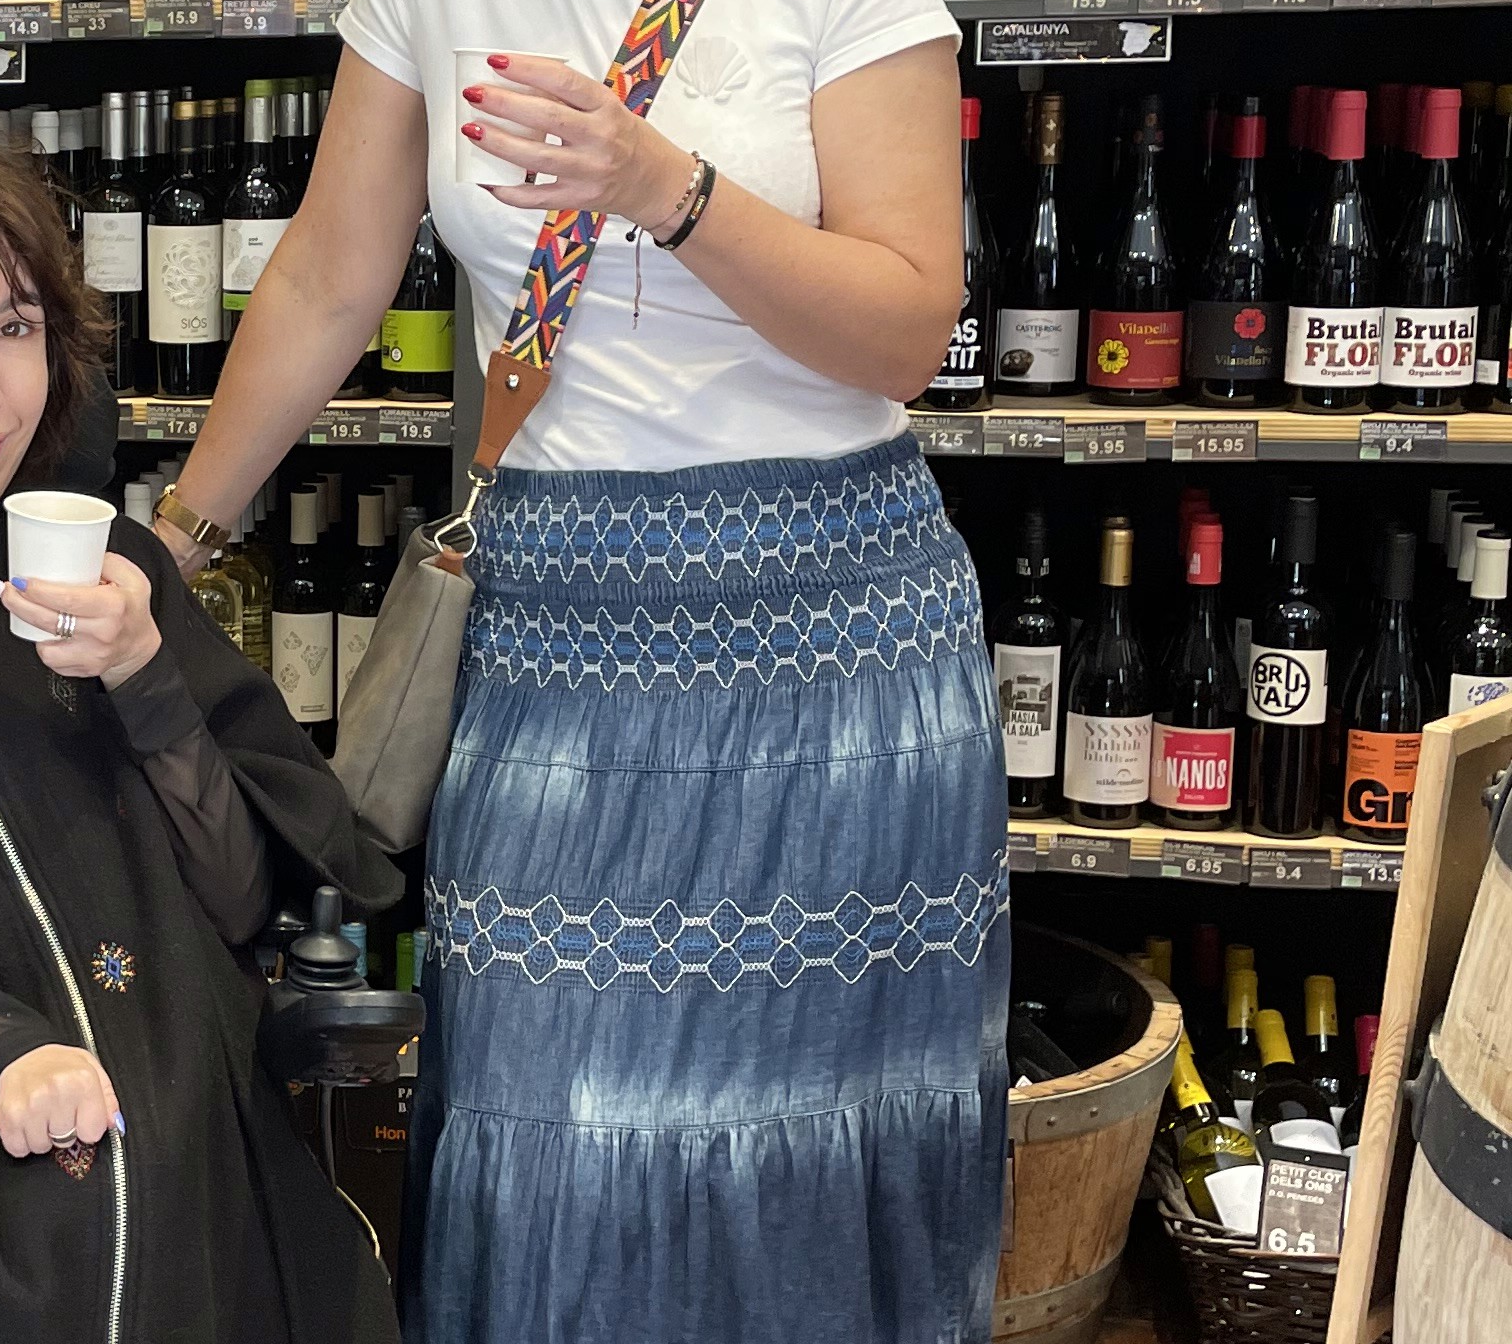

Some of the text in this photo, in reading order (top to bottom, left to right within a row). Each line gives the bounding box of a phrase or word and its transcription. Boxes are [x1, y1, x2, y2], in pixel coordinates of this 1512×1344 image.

[88, 16, 106, 32] 33
[167, 10, 198, 26] 15.9
[243, 15, 266, 31] 9.9
[9, 20, 39, 35] 14.9
[992, 22, 1069, 37] CATALUNYA
[1394, 317, 1474, 342] Brutal
[1304, 342, 1380, 367] FLOR
[1393, 342, 1473, 367] FLOR
[167, 418, 197, 435] 17.8
[330, 422, 361, 438] 19.5
[400, 423, 432, 438] 19.5
[929, 431, 963, 448] 12.5
[1089, 438, 1125, 455] 9.95
[1197, 437, 1244, 453] 15.95
[1386, 437, 1413, 453] 9.4
[1166, 755, 1226, 789] NANOS
[1071, 852, 1097, 868] 6.9
[1186, 858, 1222, 875] 6.95
[1276, 863, 1302, 880] 9.4
[1271, 1164, 1341, 1184] PETIT CLOT
[1270, 1175, 1333, 1193] DELS OMS
[1268, 1228, 1316, 1253] 6.5
